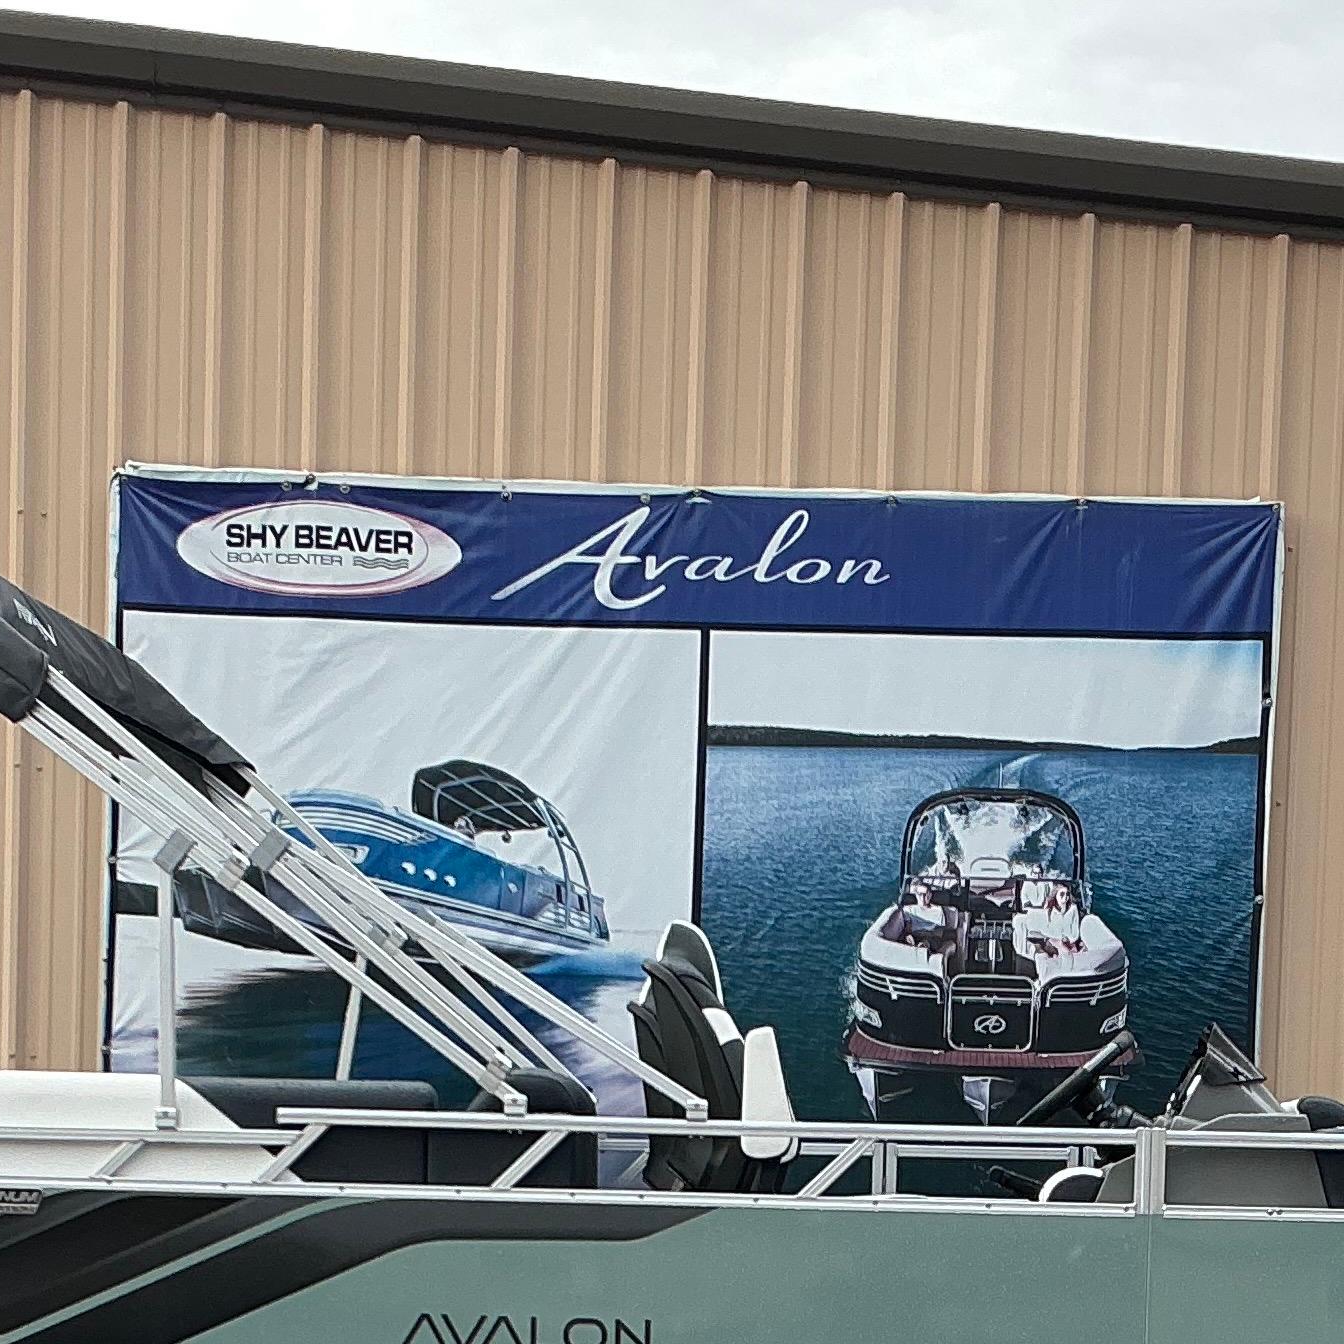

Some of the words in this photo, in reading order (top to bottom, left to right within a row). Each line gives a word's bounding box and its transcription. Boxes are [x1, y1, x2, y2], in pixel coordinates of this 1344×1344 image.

[225, 523, 289, 549] SHY
[293, 525, 414, 555] BEAVER
[226, 552, 272, 565] BOAT
[275, 553, 343, 567] CENTER
[490, 505, 891, 610] Avalon
